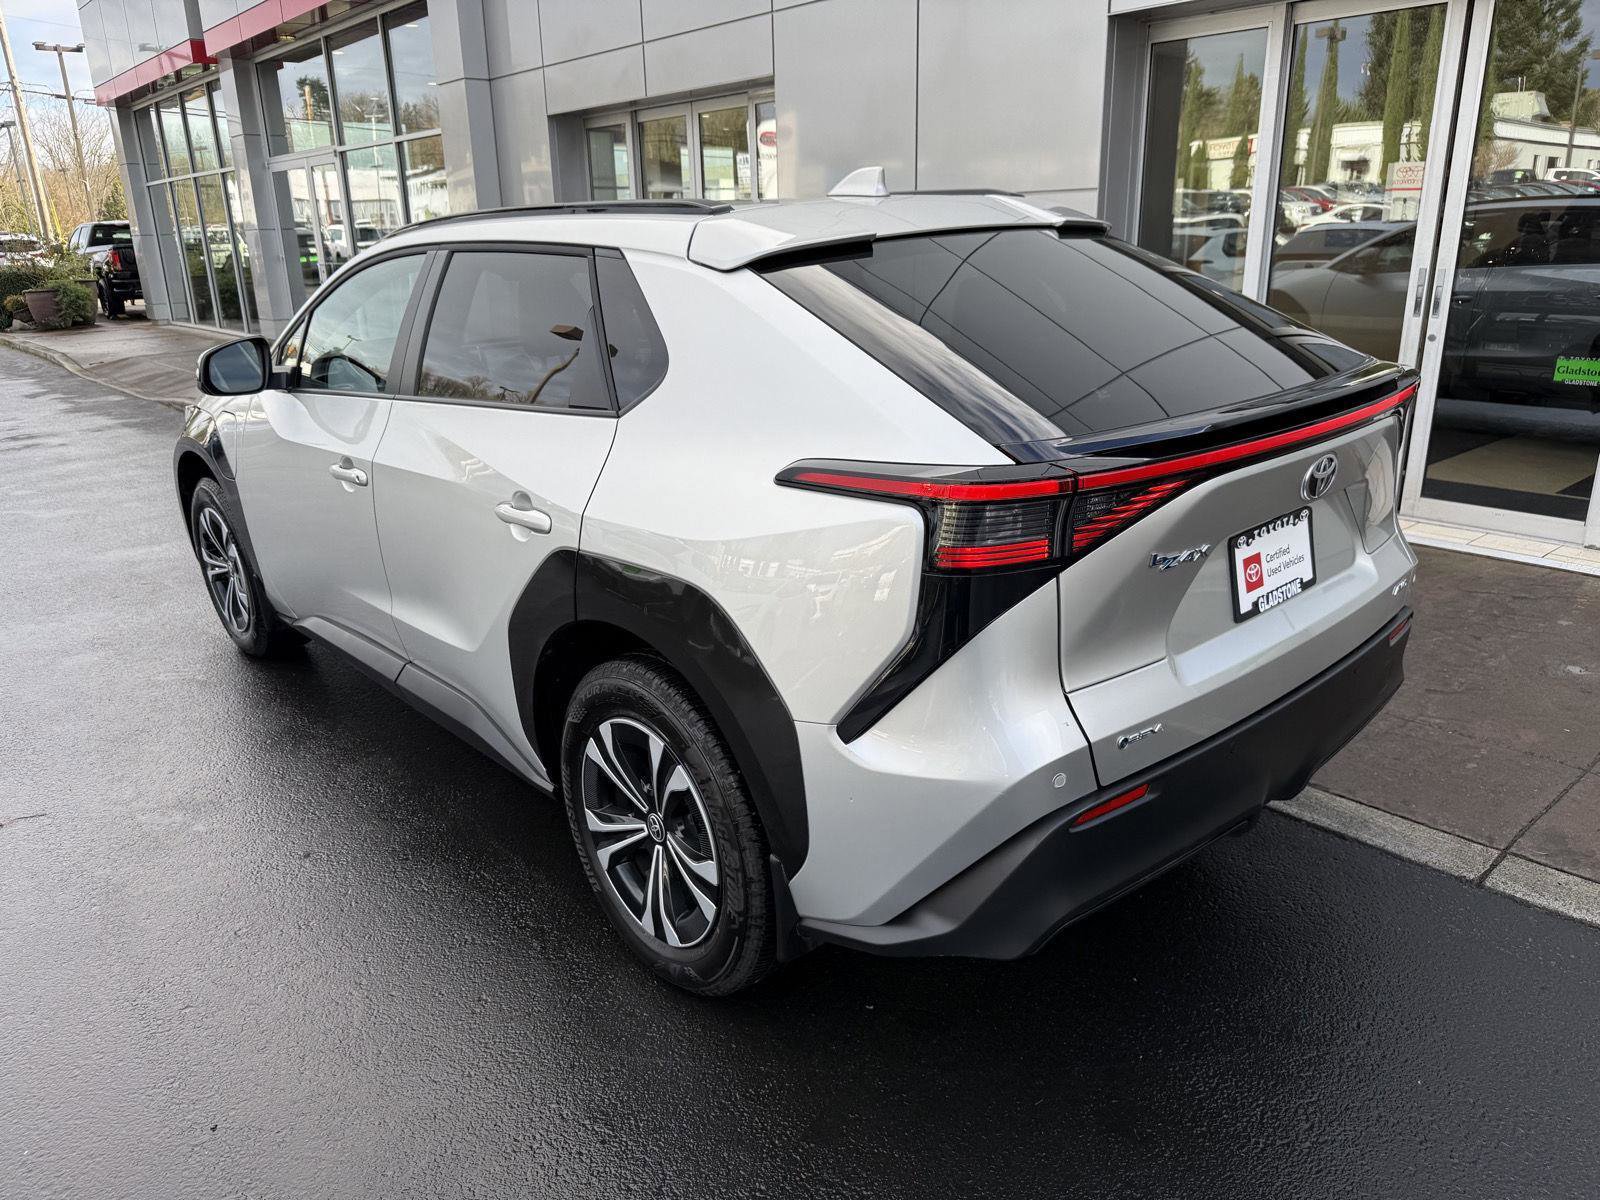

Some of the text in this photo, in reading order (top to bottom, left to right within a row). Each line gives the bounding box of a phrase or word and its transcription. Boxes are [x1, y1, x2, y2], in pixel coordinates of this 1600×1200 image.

[1253, 515, 1295, 540] TOYOTA
[1265, 544, 1291, 563] Certified
[1266, 554, 1305, 578] Used Vehicles
[1258, 578, 1302, 612] GLADSTONE
